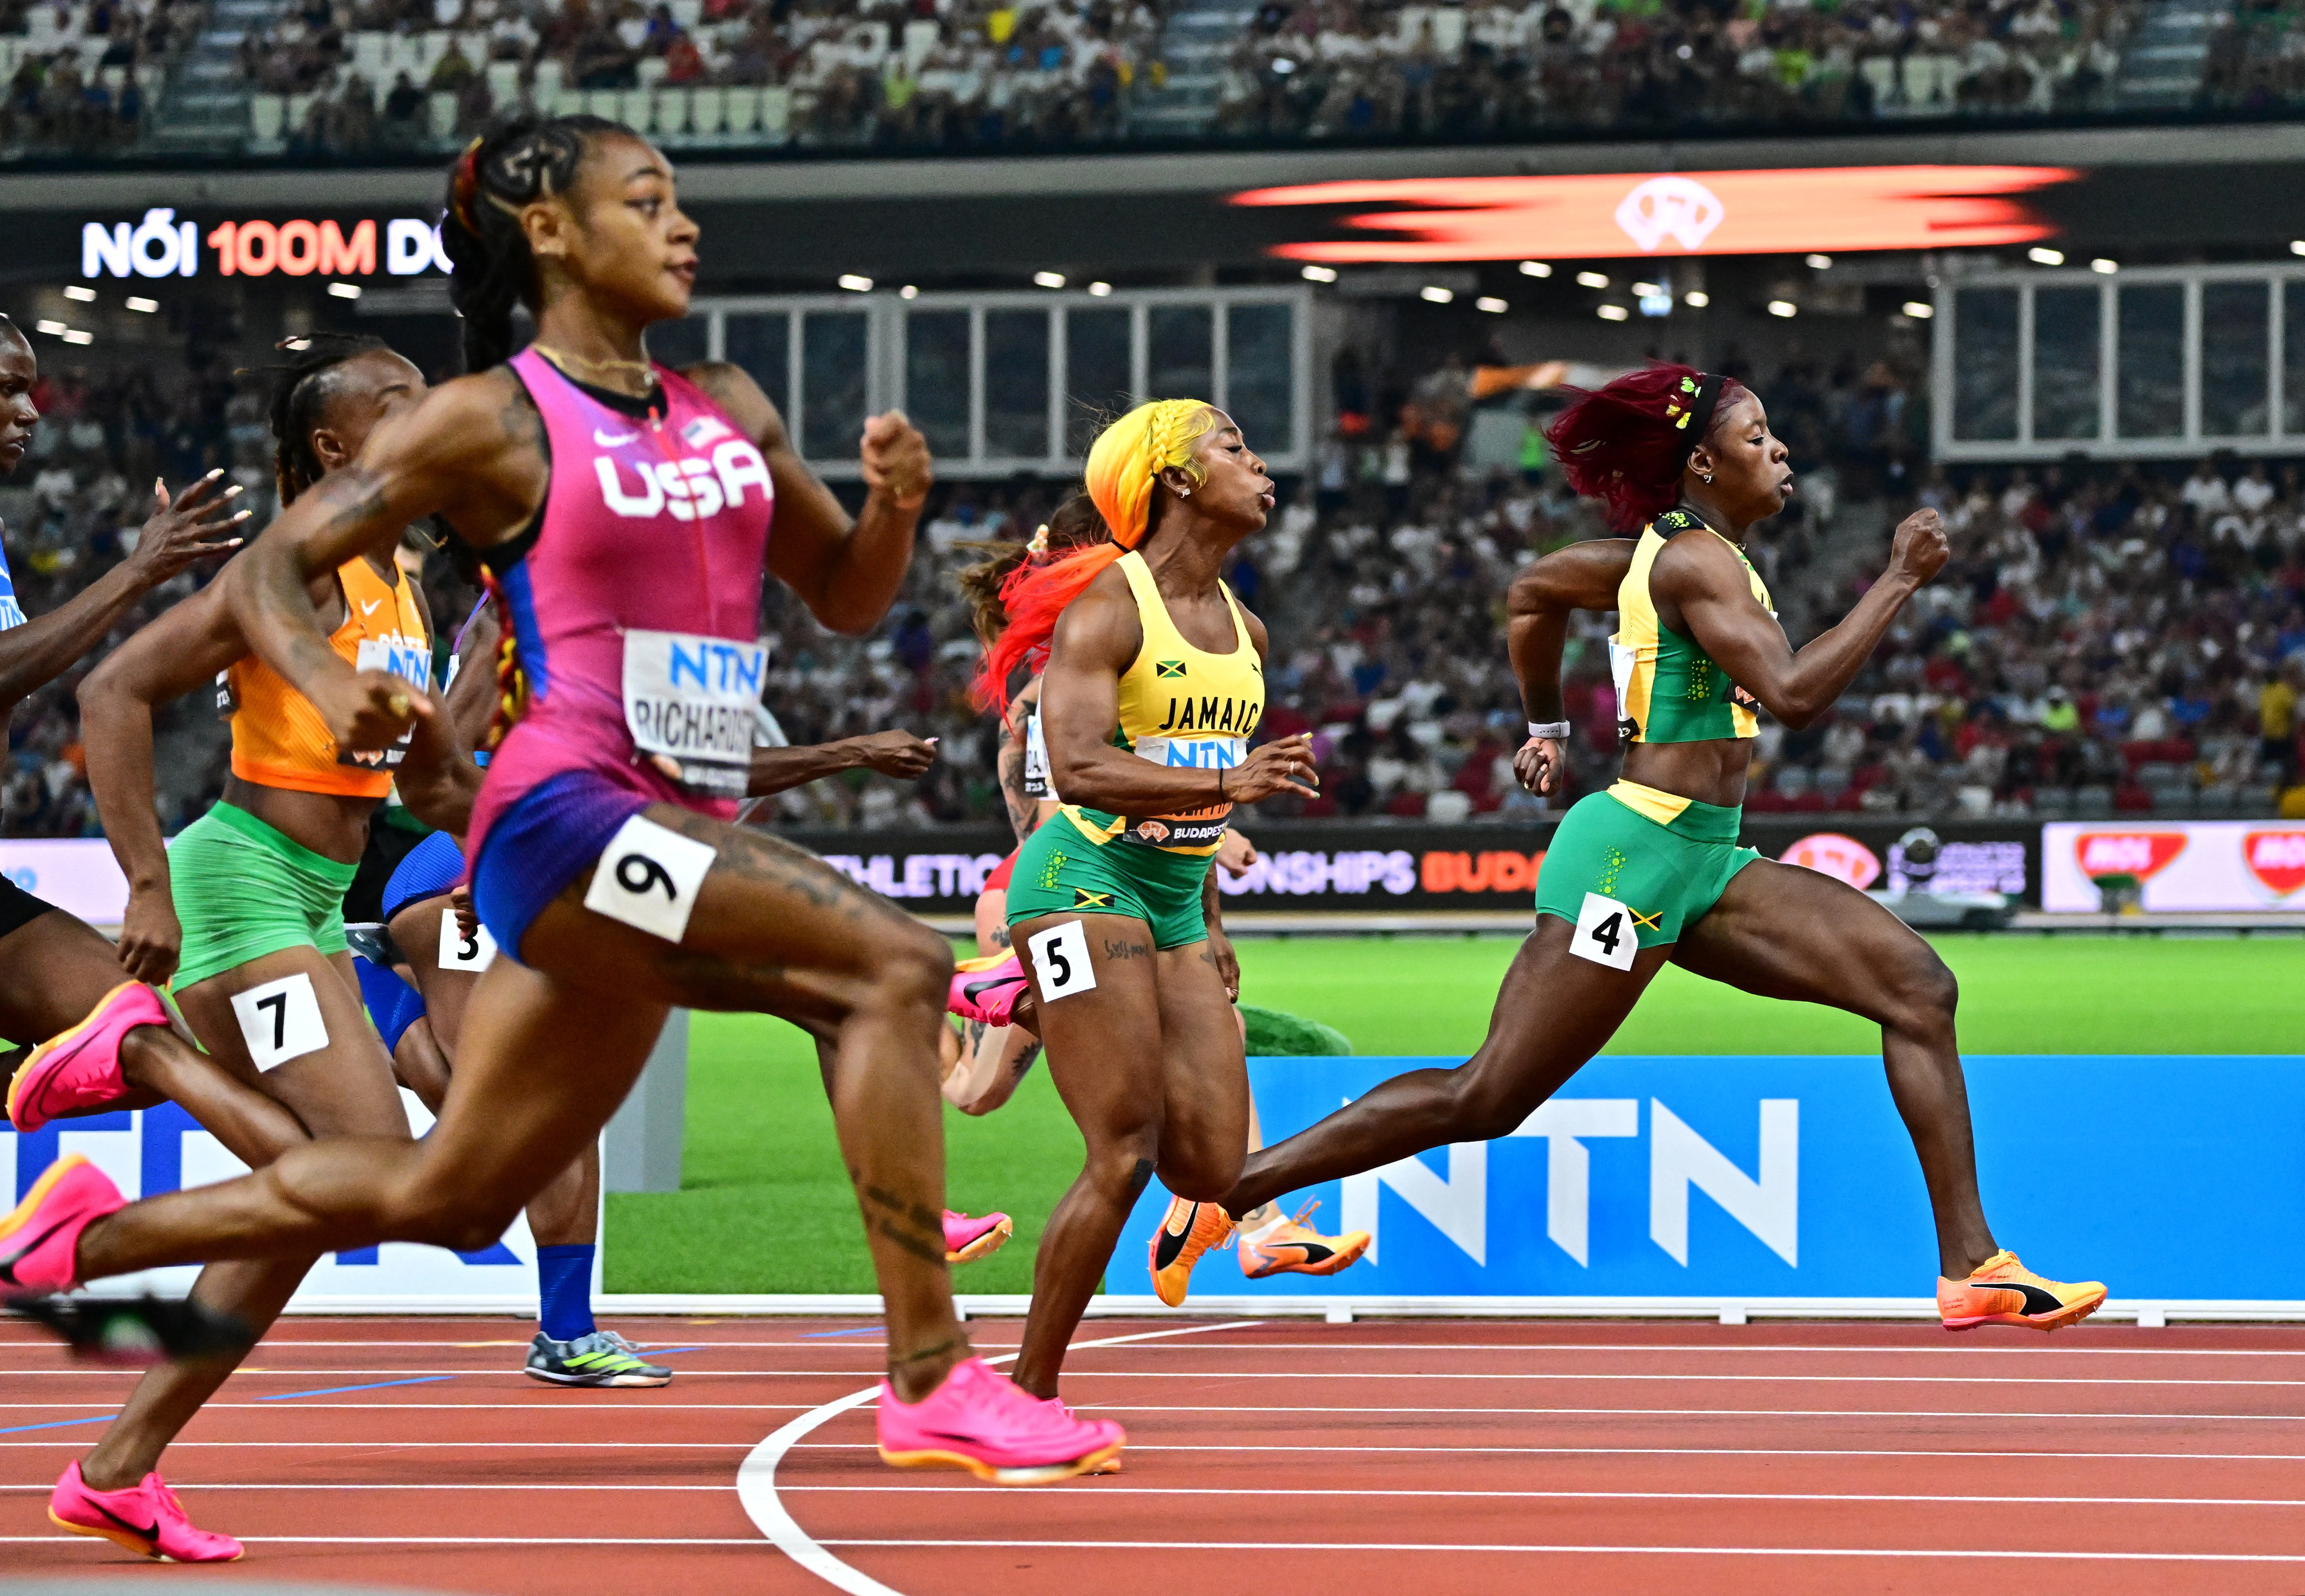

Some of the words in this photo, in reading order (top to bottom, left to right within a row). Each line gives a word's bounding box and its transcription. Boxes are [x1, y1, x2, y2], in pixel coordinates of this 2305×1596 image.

[208, 220, 376, 276] 100M
[593, 439, 774, 521] USA
[671, 641, 761, 694] NTN
[1158, 696, 1259, 736] JAMAIC
[1167, 740, 1235, 769] NTN
[616, 854, 677, 900] 9
[1592, 912, 1623, 955] 4
[1047, 937, 1071, 987] 5
[256, 991, 286, 1050] 7
[1341, 1097, 1799, 1269] NTN
